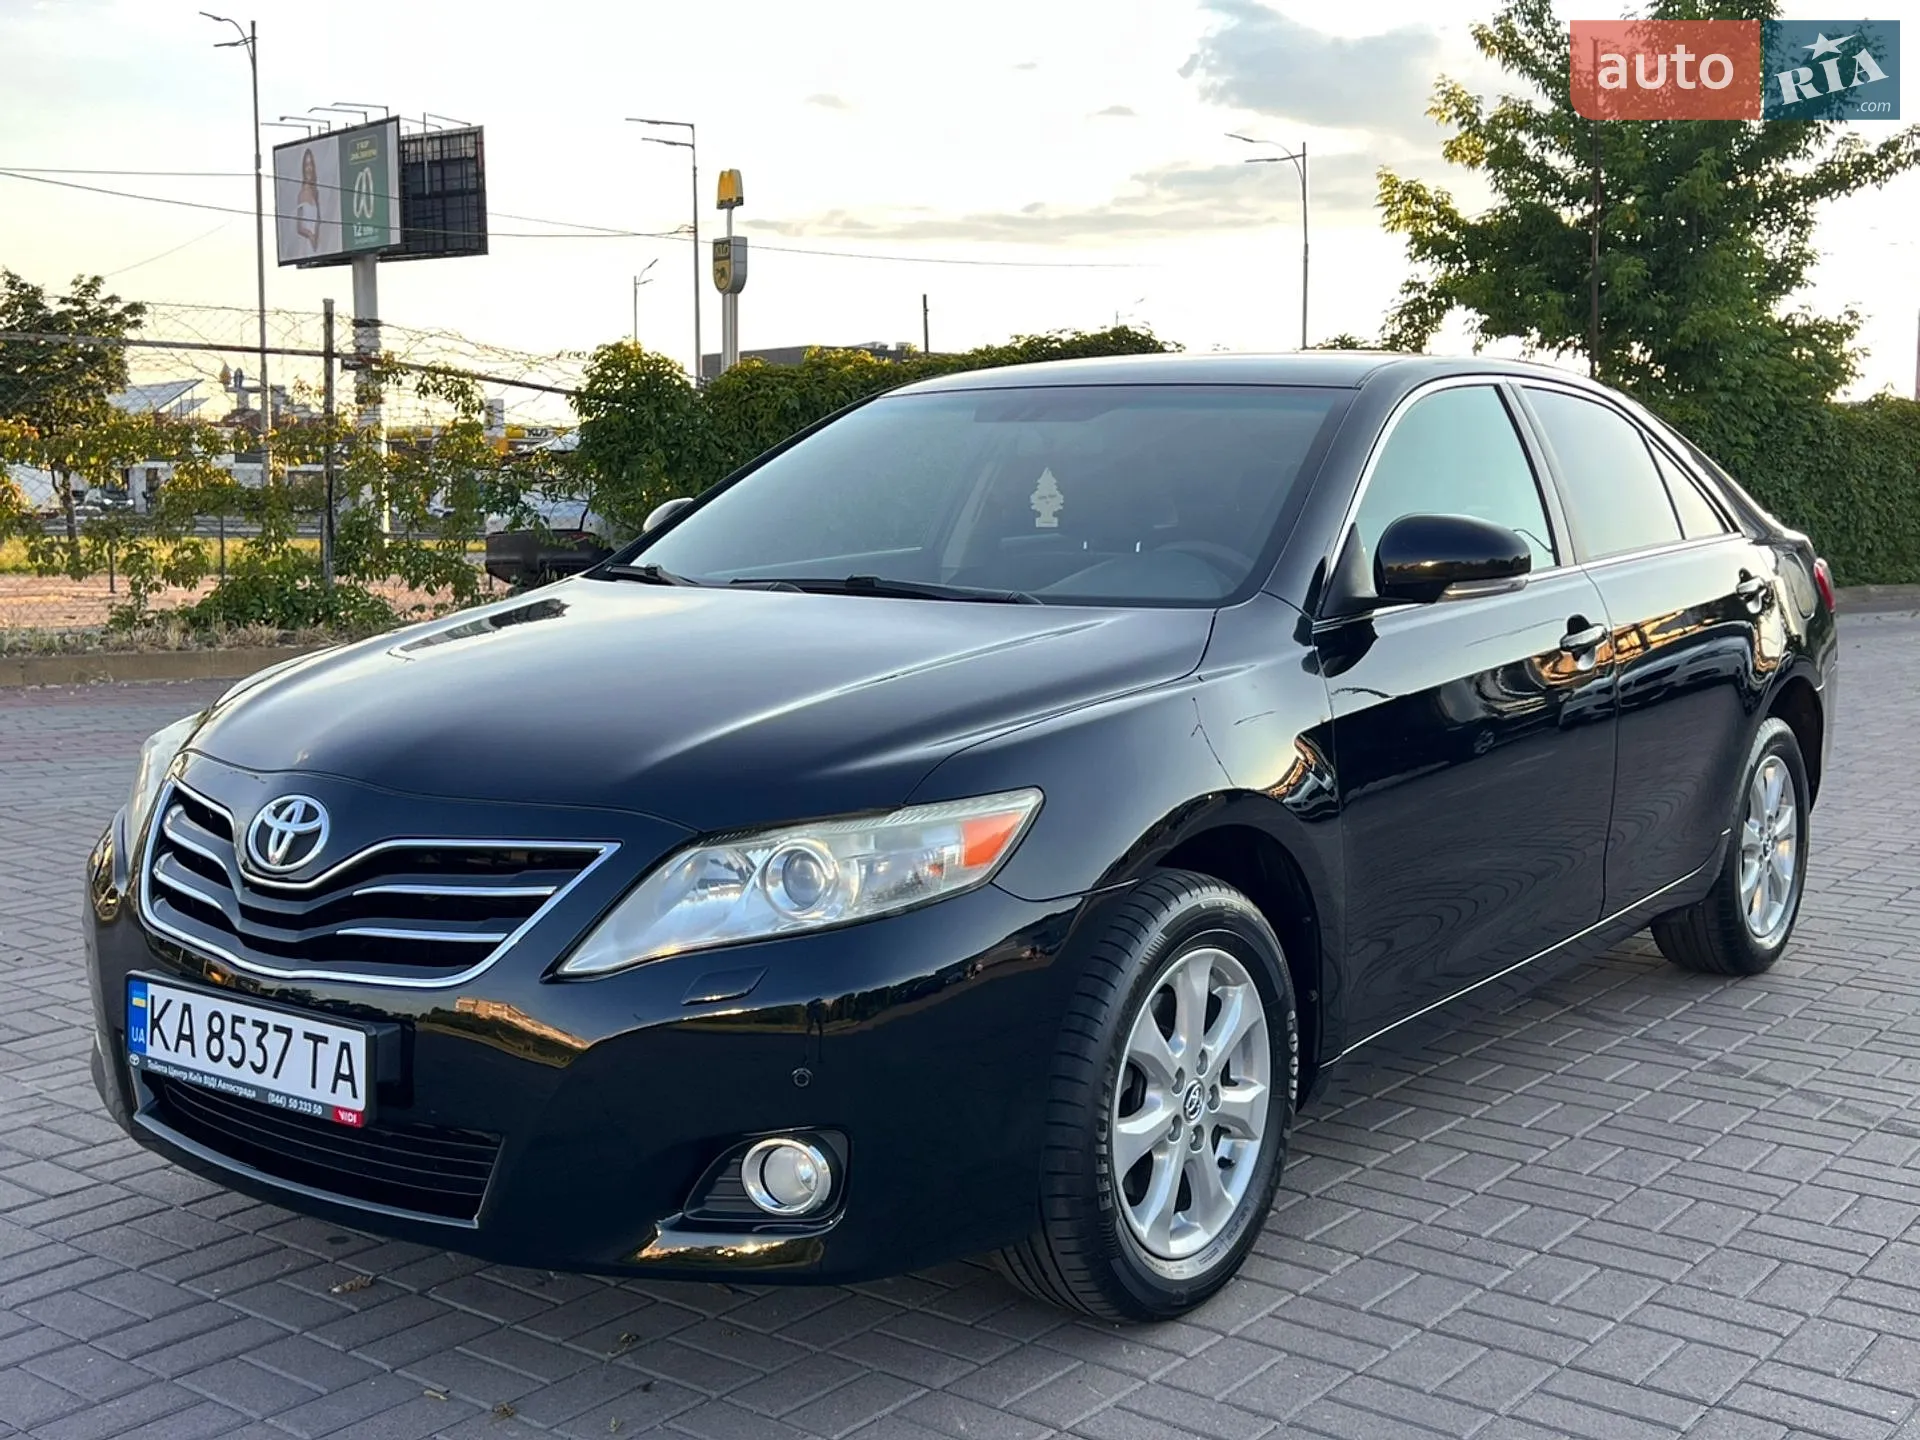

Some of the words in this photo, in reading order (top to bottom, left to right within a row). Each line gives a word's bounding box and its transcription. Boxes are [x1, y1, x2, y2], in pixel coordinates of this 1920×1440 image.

[131, 1026, 145, 1044] UA
[149, 995, 196, 1058] KA
[206, 1010, 293, 1080] 8537
[303, 1031, 358, 1098] TA
